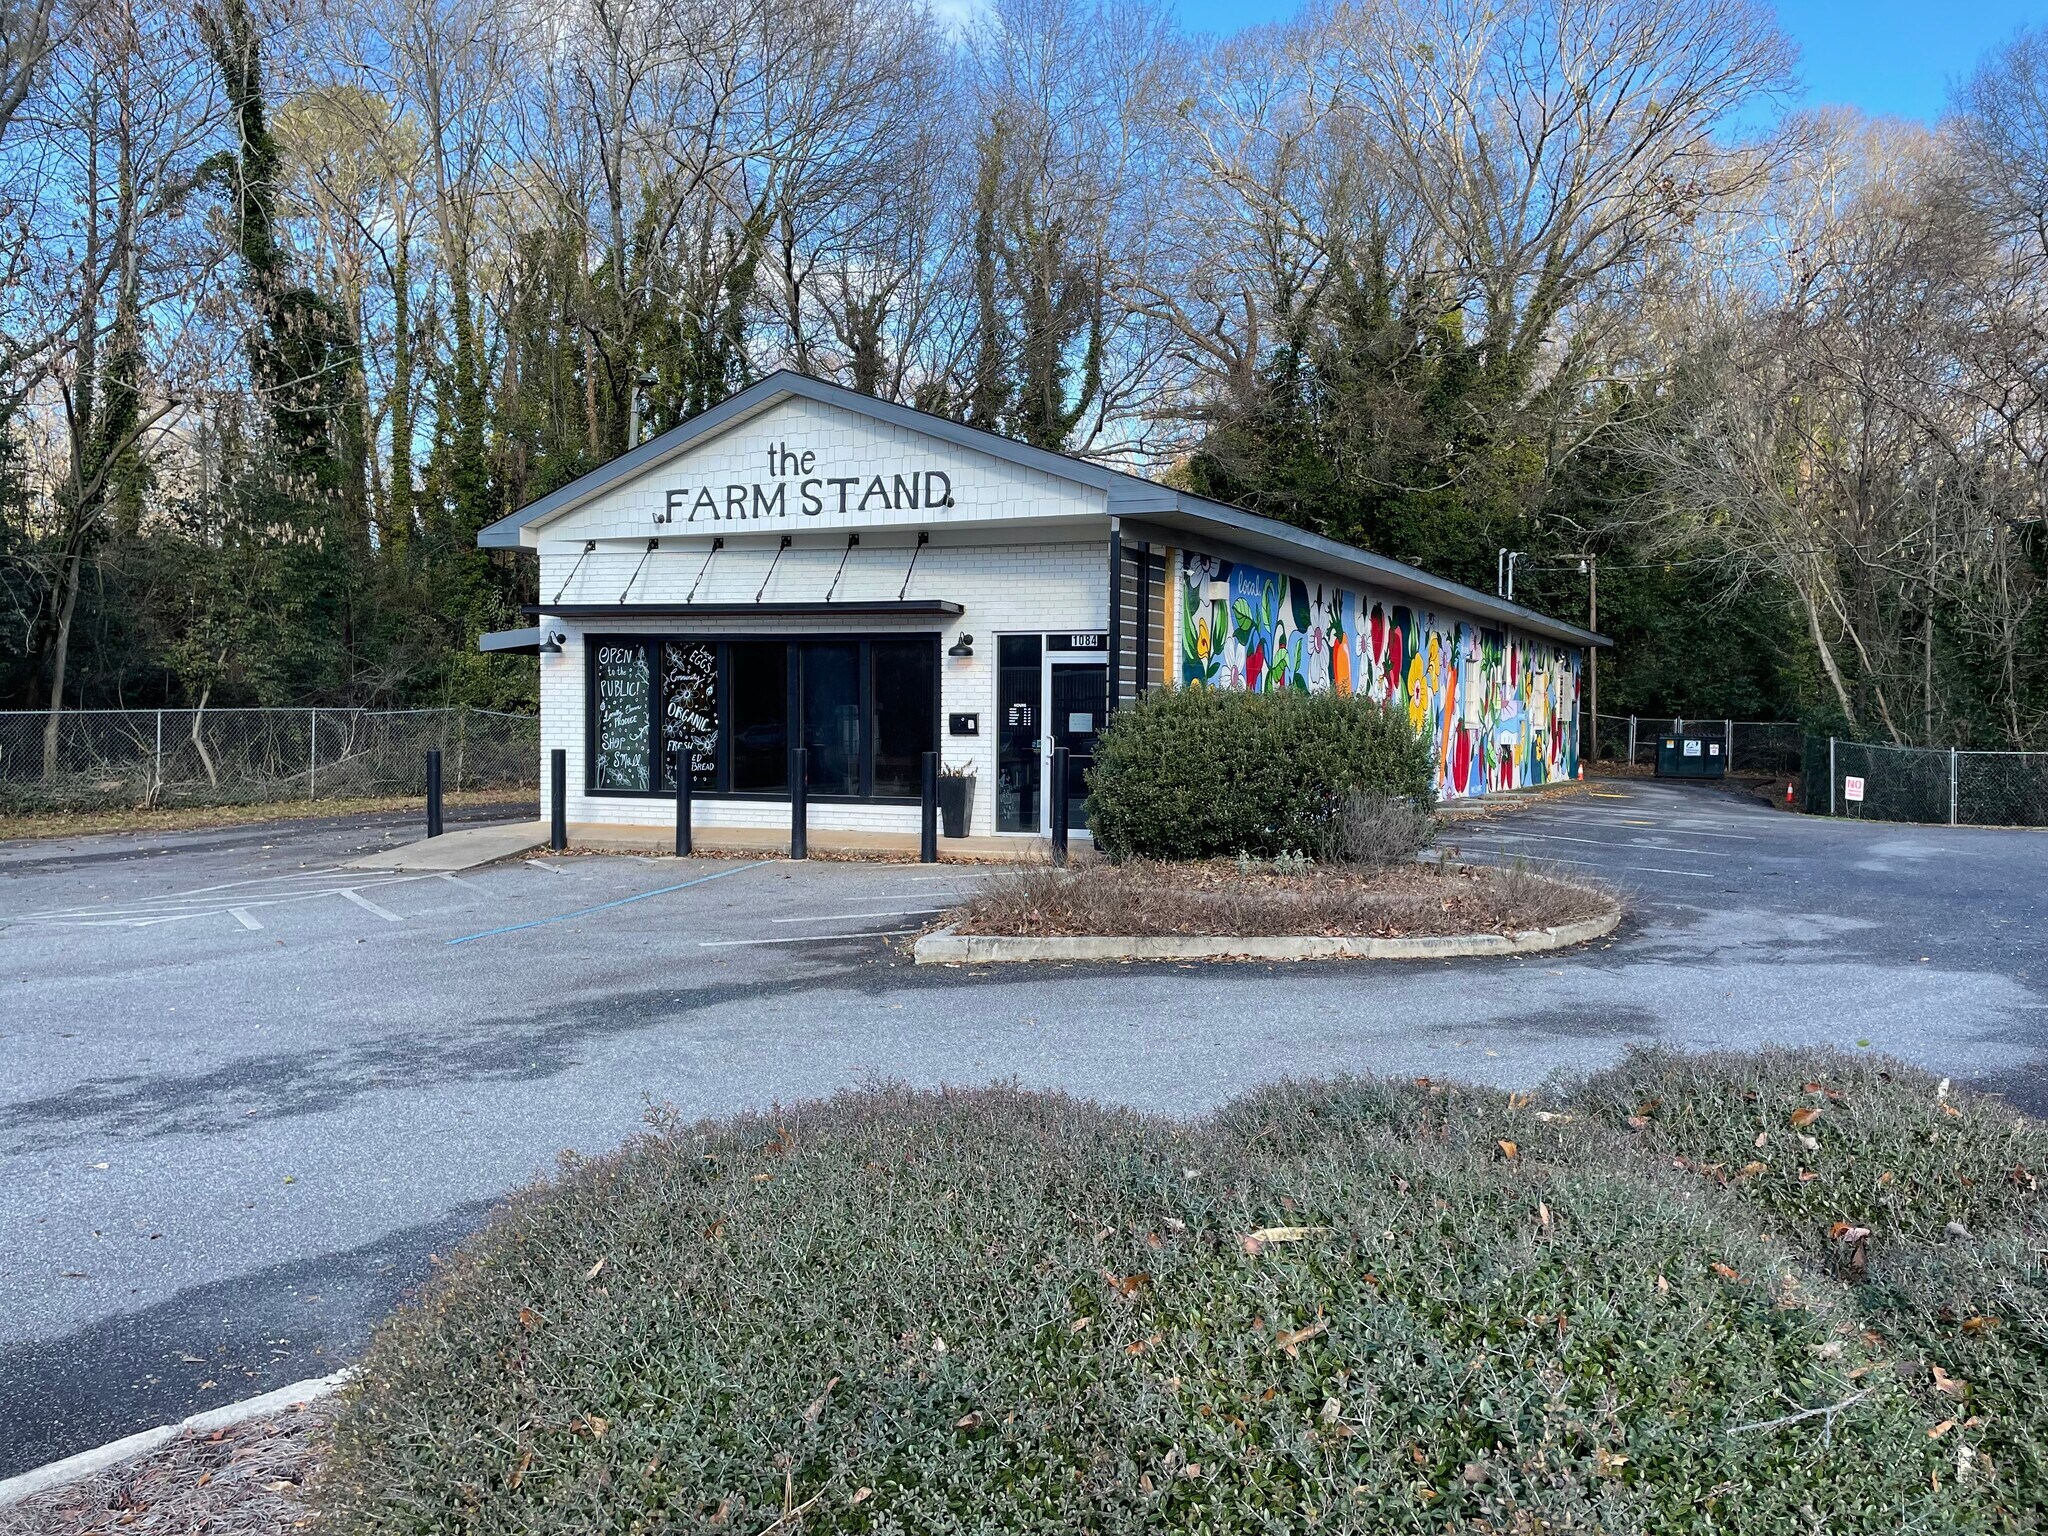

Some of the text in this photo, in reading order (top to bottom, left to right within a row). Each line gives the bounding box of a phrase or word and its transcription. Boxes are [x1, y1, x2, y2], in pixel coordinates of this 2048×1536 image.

[768, 442, 816, 477] the
[666, 471, 951, 523] FARM STAND
[1073, 635, 1097, 645] 1084
[599, 646, 633, 664] OPEN
[689, 650, 712, 673] EGGS
[607, 666, 627, 677] to the
[600, 680, 640, 697] PUBLIC!
[614, 715, 637, 728] PRODUCE
[601, 732, 626, 750] SHOP
[691, 762, 714, 771] BREAD
[1847, 779, 1862, 789] NO
